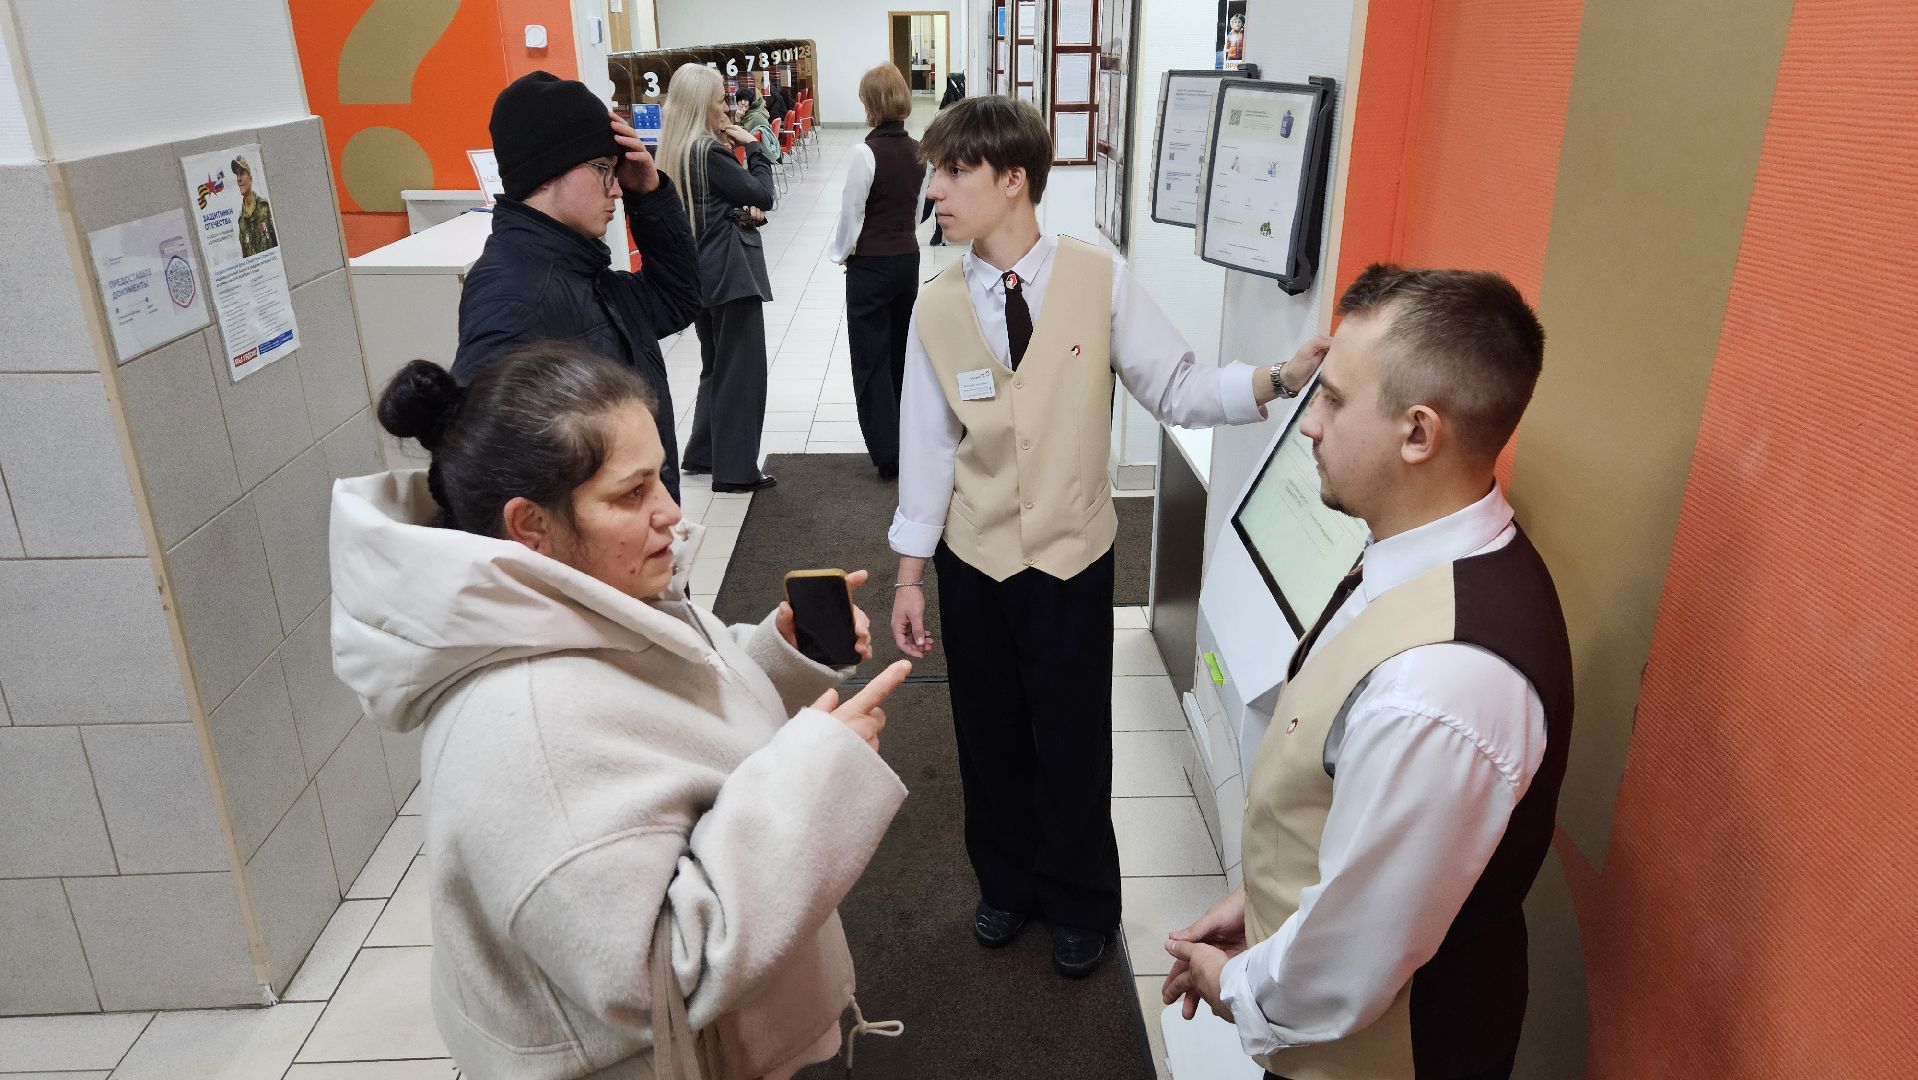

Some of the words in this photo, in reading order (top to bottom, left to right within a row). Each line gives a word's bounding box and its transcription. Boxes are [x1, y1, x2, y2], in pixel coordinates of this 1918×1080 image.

[745, 55, 755, 72] 7
[759, 52, 770, 68] 8
[770, 50, 781, 66] 9
[726, 57, 739, 77] 6
[643, 71, 661, 98] 3
[203, 208, 234, 222] ЗАЩИТНИКИ
[204, 219, 232, 231] ОТЕЧЕСТВА
[112, 280, 150, 301] ДОКУМЕНТЫ
